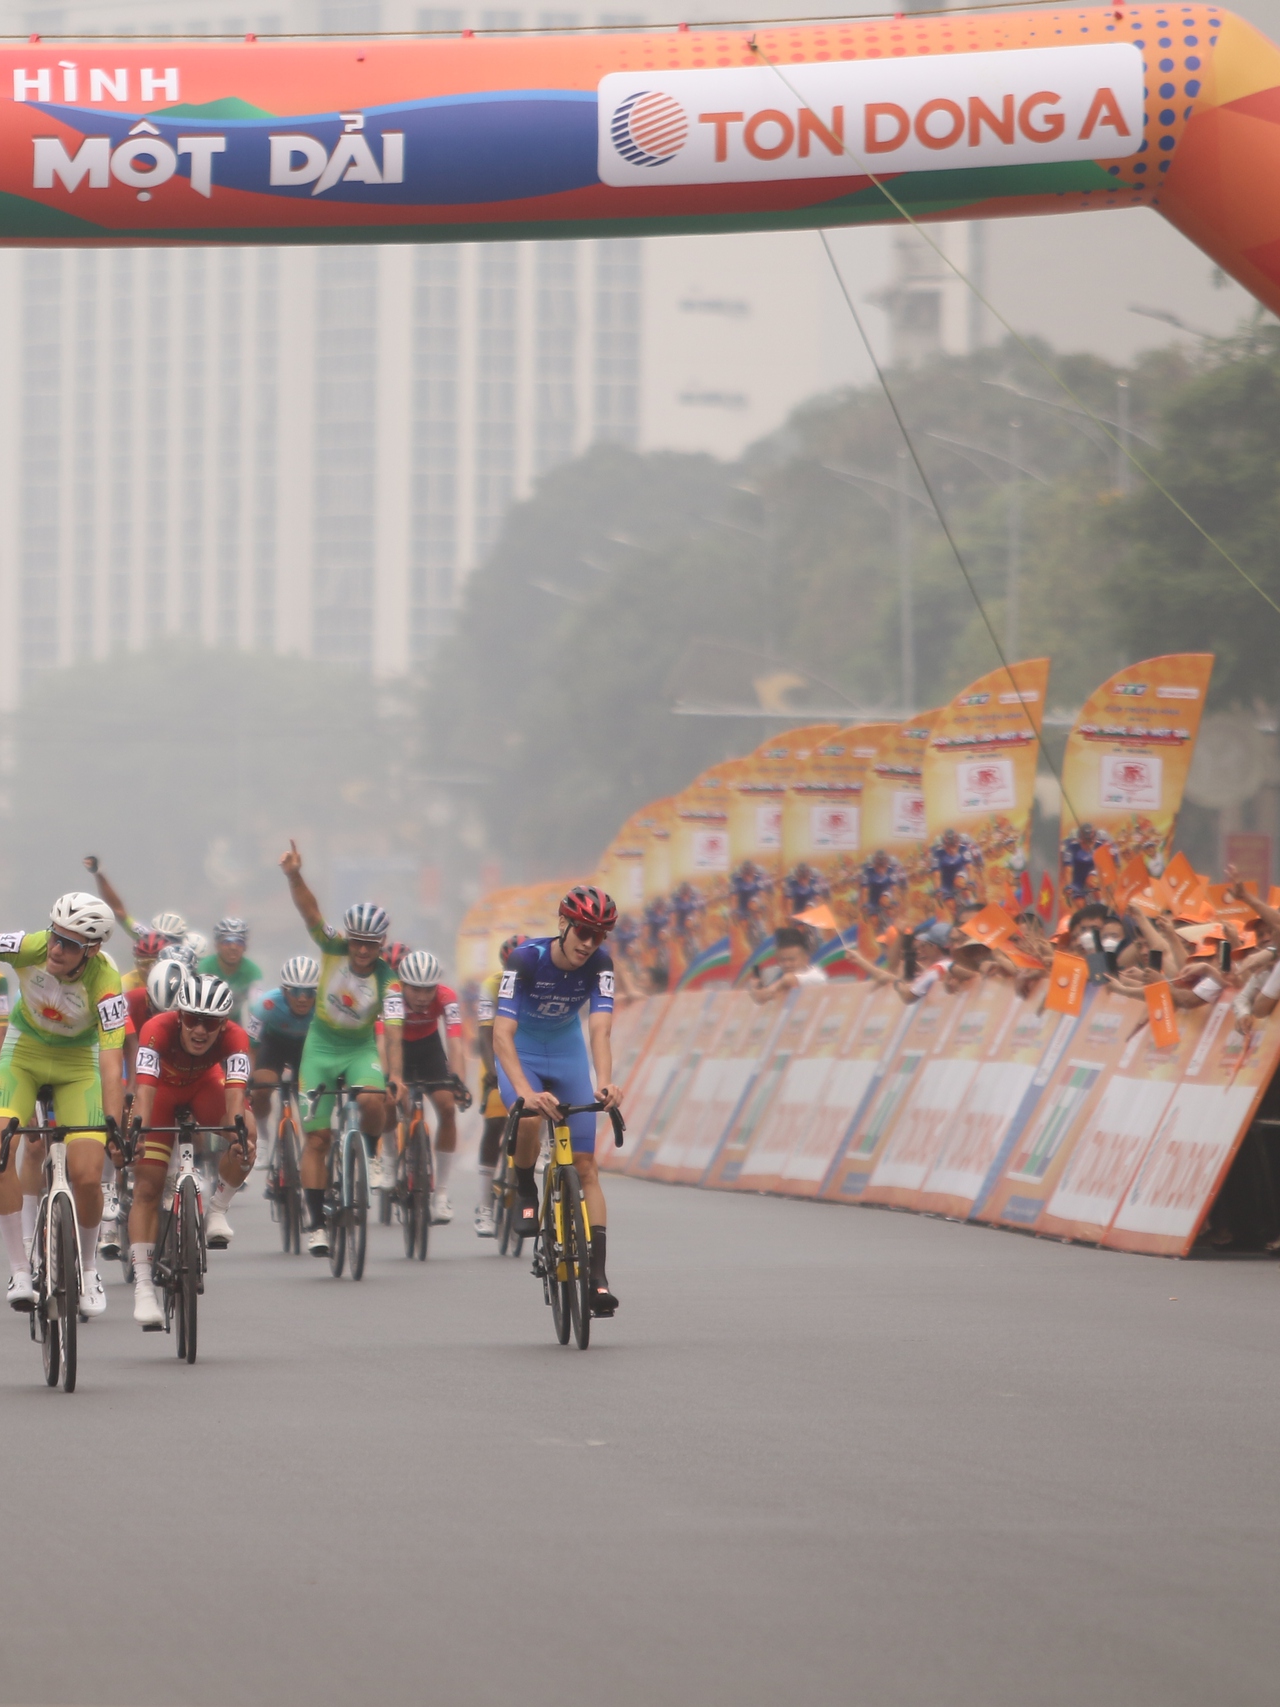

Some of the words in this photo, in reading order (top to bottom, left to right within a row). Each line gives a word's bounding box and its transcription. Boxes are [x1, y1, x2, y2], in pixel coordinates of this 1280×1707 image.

[13, 60, 180, 102] HÌNH
[698, 105, 845, 163] TON
[863, 90, 1067, 155] DONG
[1077, 87, 1132, 141] A
[32, 120, 228, 203] MỘT
[268, 112, 405, 197] DẢI
[101, 1000, 124, 1023] 147
[137, 1052, 159, 1072] 121
